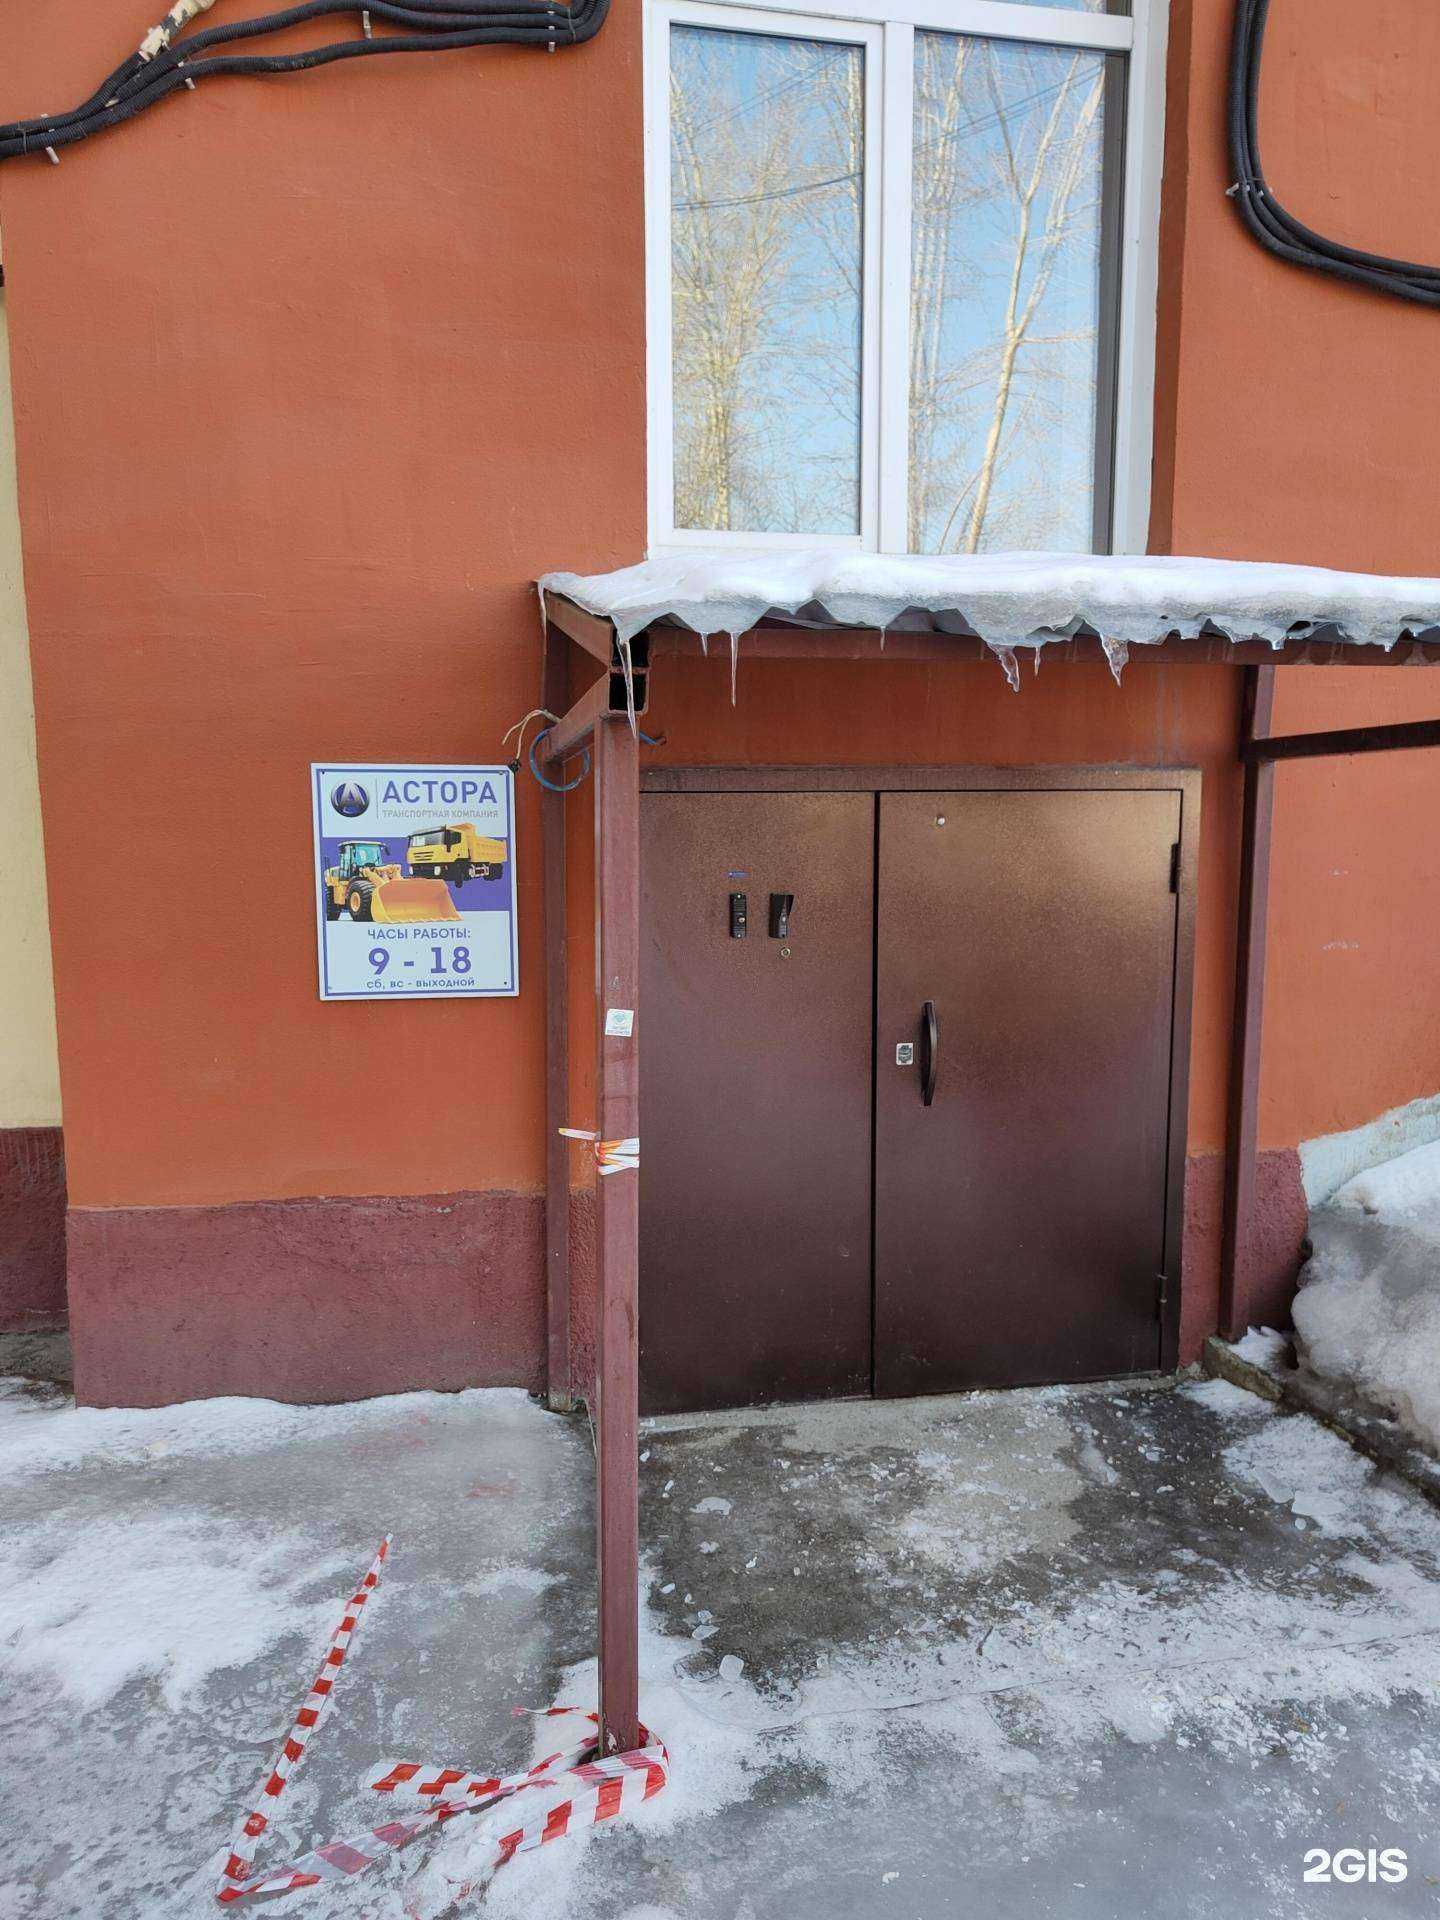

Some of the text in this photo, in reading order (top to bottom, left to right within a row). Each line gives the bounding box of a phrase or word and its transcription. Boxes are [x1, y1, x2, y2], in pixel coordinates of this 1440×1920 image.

[382, 780, 498, 804] АСТОРА
[382, 809, 499, 819] ТРАНСПОРТНАЯ КОМПАНИЯ
[368, 928, 471, 939] ЧАСЫ РАБОТЫ:
[368, 947, 390, 975] 9
[430, 946, 472, 974] 18
[366, 979, 386, 990] сб,
[390, 979, 404, 988] вс
[416, 977, 475, 988] выходной
